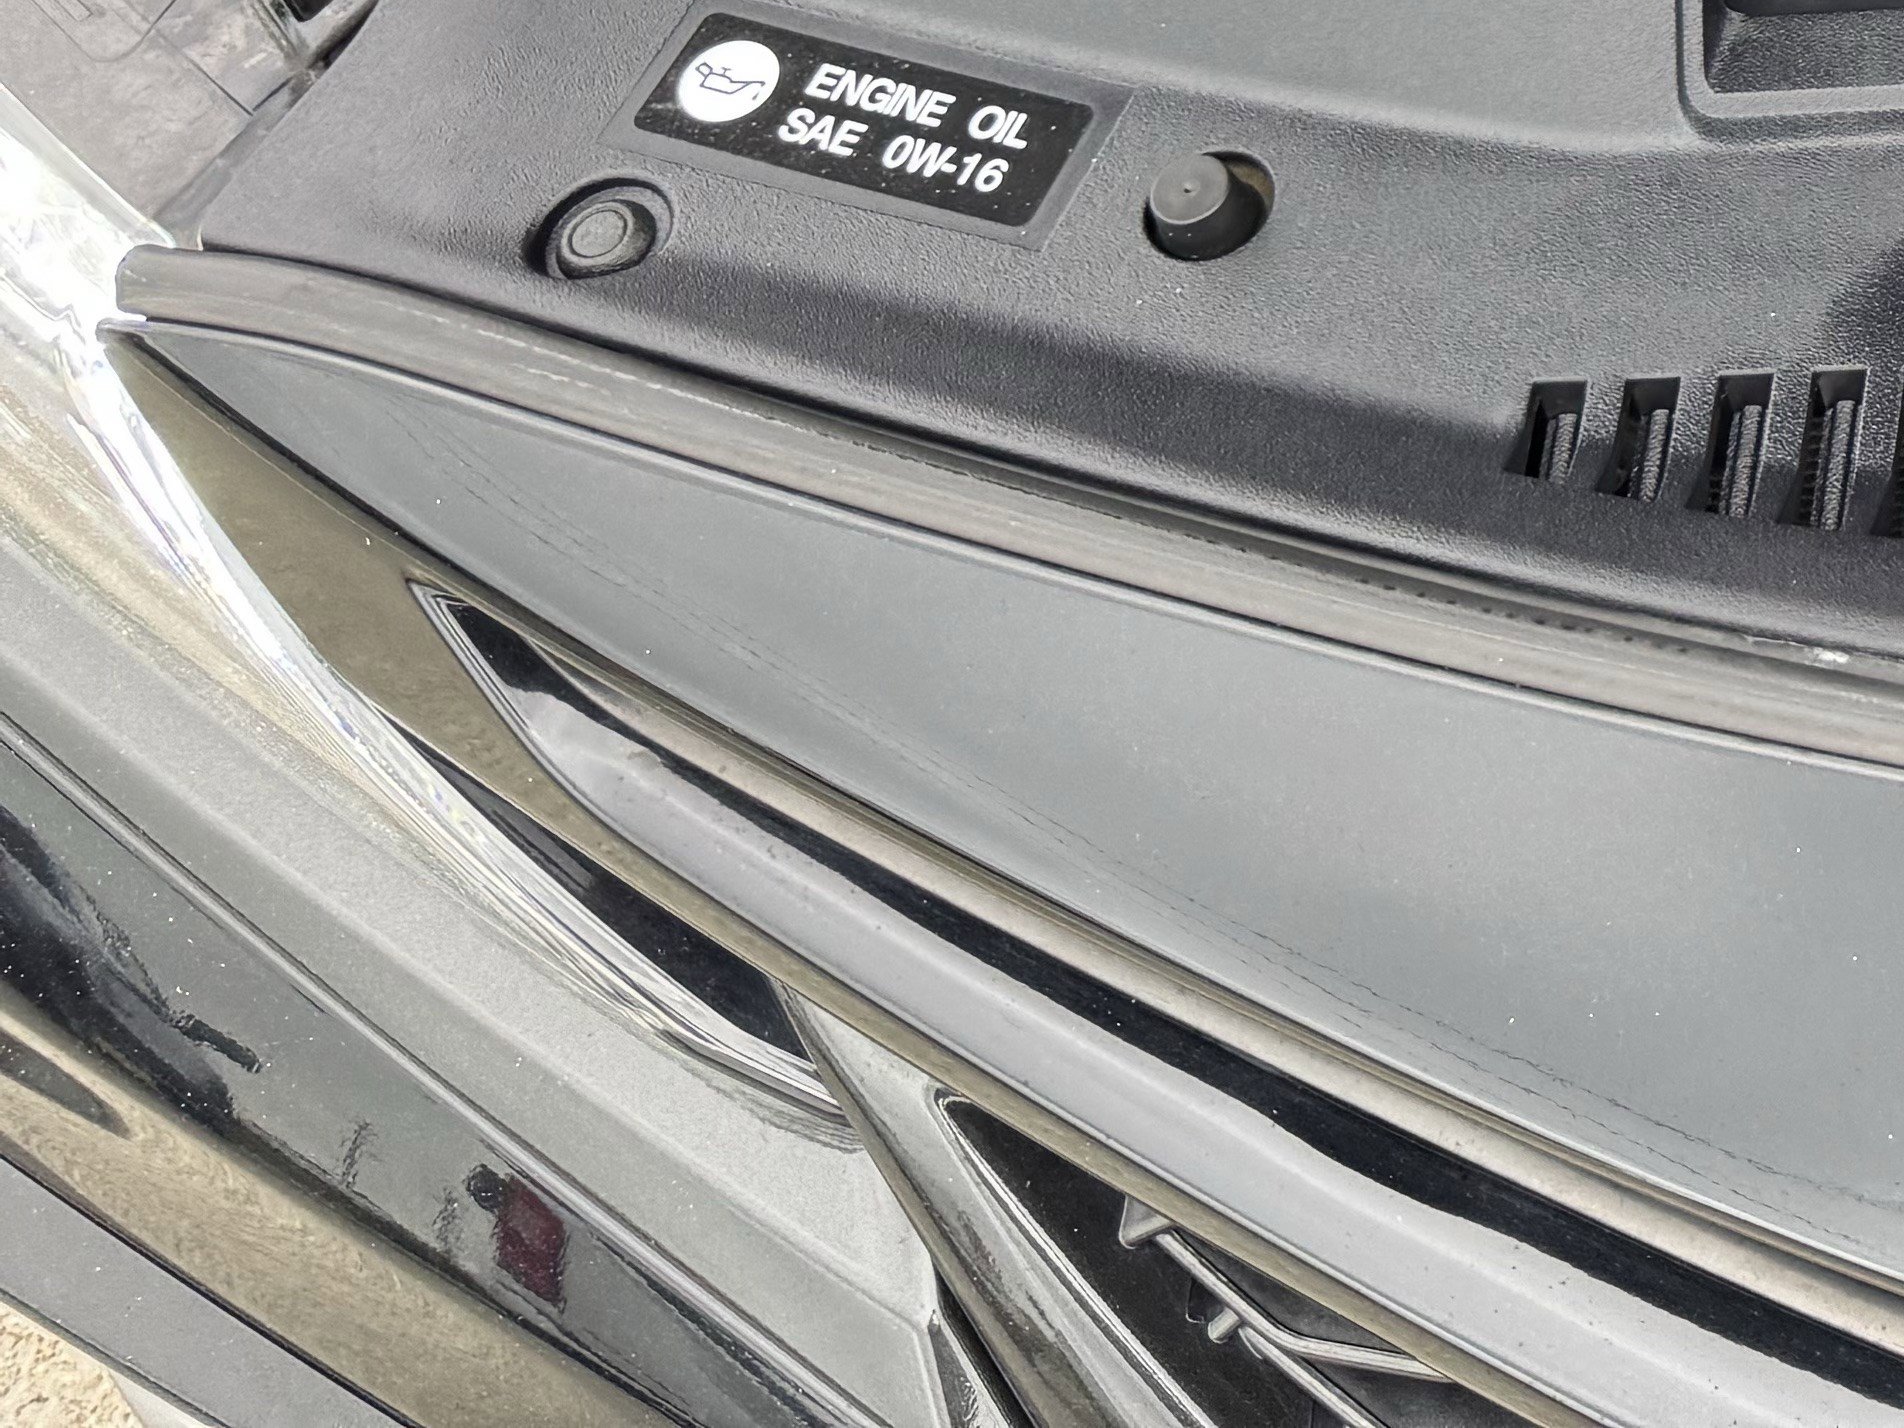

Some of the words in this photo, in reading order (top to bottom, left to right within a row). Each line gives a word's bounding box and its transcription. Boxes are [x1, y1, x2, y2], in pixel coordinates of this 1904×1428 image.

[777, 106, 868, 159] SAE
[881, 134, 1009, 193] 0W-16
[804, 62, 957, 128] ENGINE
[967, 103, 1029, 151] OIL
